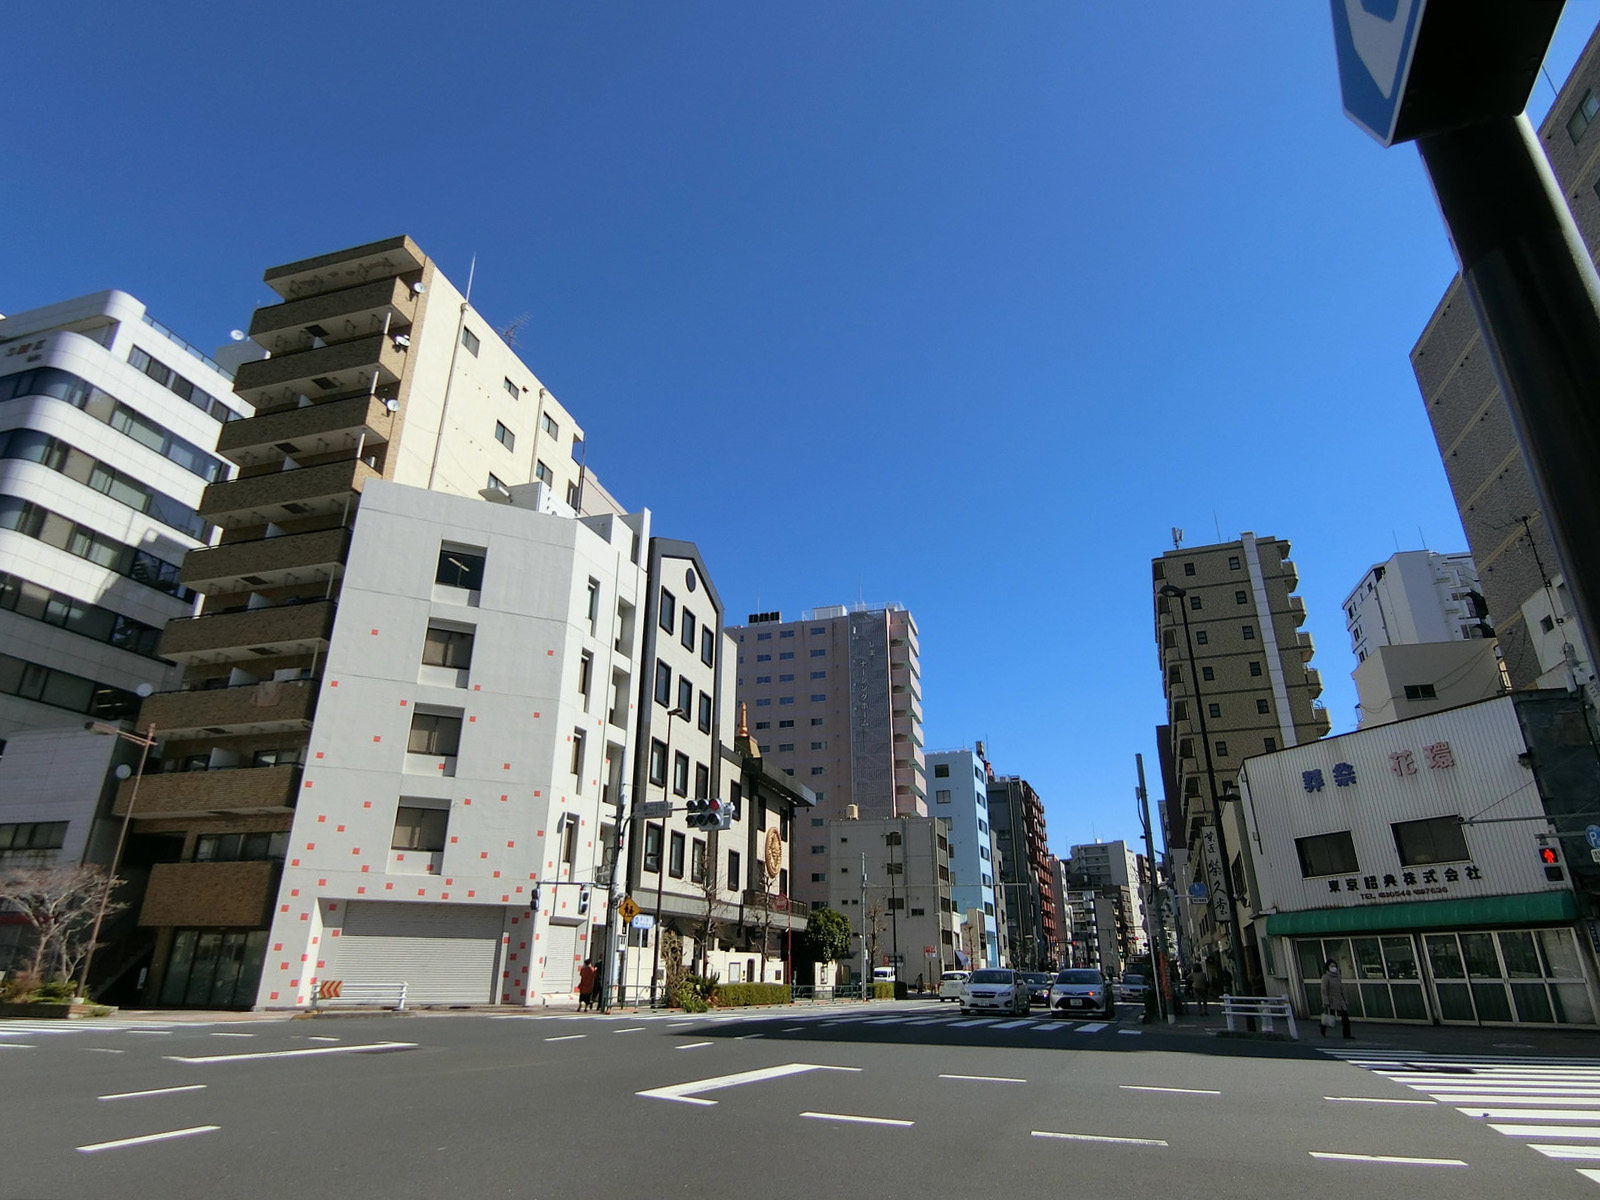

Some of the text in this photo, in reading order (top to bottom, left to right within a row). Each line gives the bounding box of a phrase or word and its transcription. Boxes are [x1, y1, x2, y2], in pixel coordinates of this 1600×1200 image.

[1388, 741, 1455, 776] 花環
[1302, 762, 1357, 793] 葬祭
[1360, 892, 1376, 900] TEL
